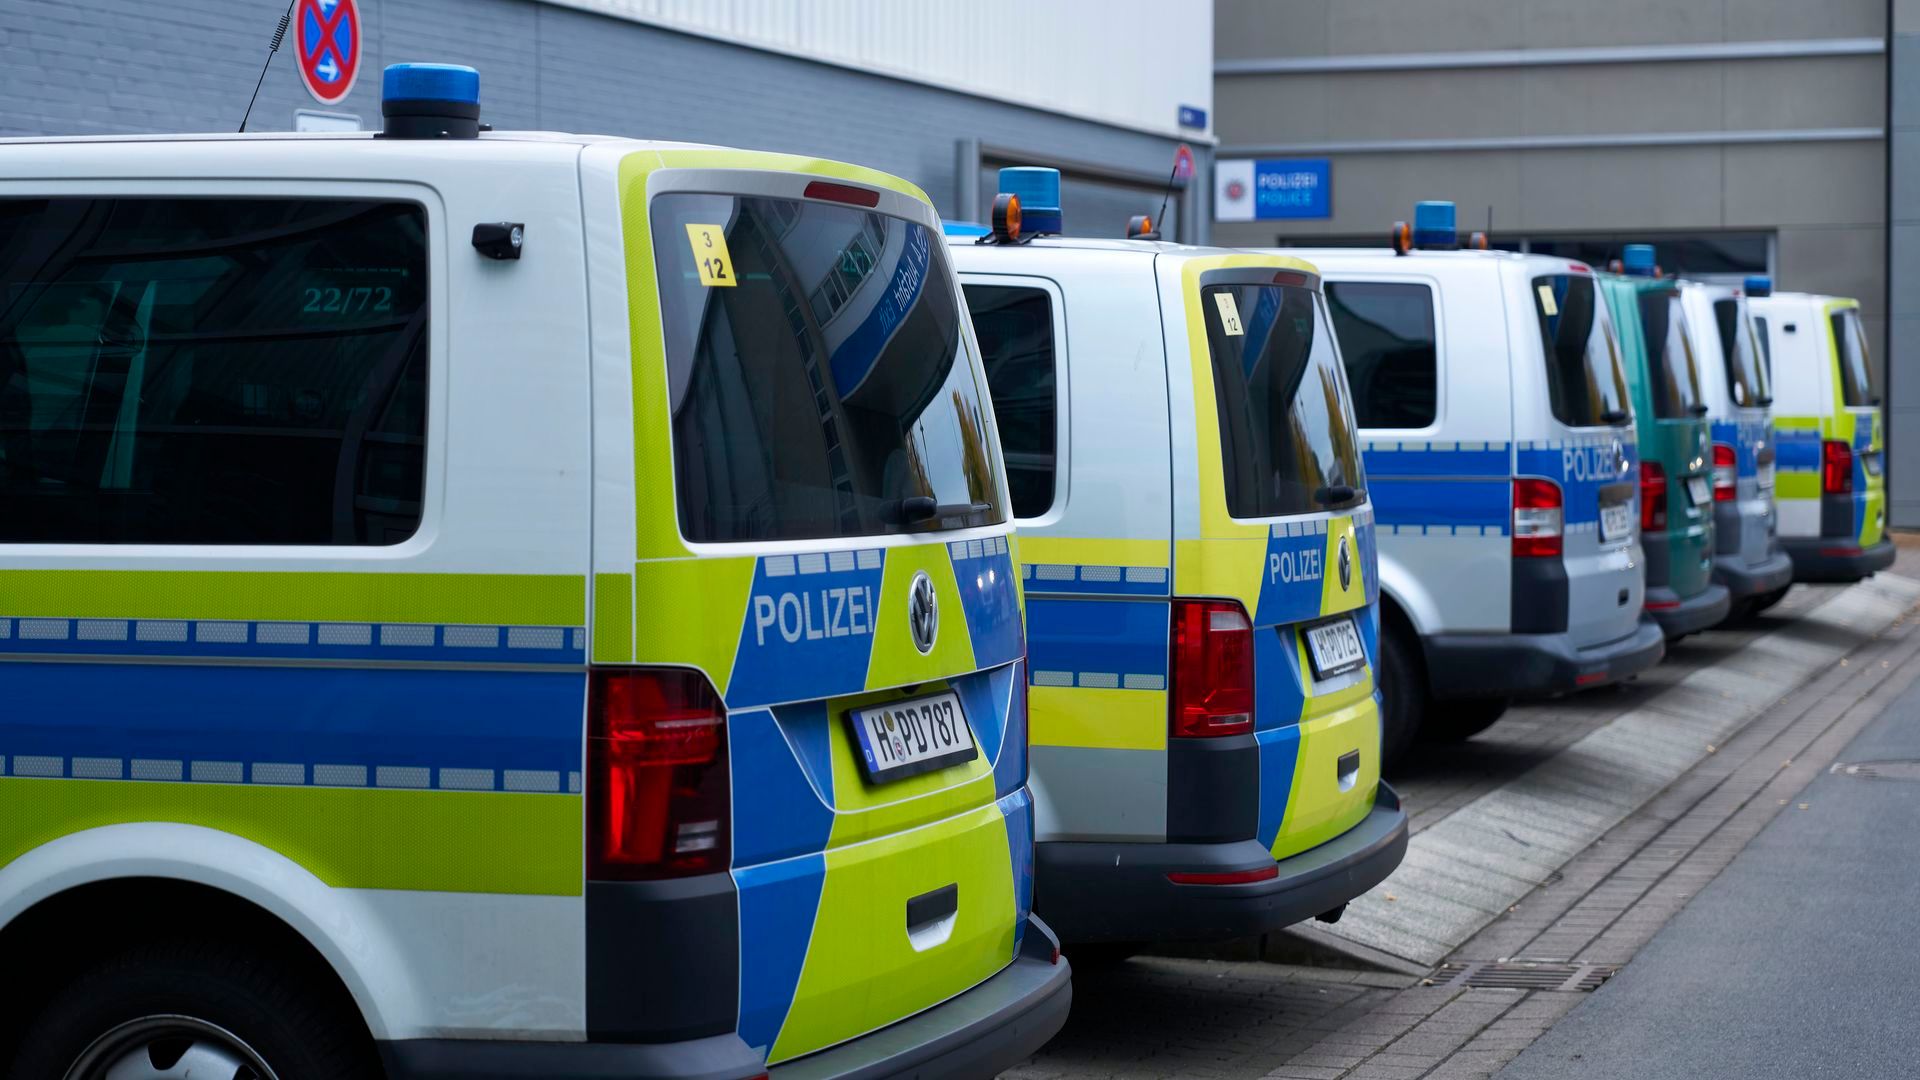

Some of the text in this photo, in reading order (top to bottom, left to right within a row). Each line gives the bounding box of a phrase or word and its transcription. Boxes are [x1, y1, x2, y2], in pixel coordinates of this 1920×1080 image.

[703, 231, 712, 248] 3
[704, 257, 727, 279] 12
[303, 286, 392, 315] 22/72
[1227, 317, 1238, 331] 12
[1270, 549, 1322, 584] POLIZEI
[754, 586, 874, 646] POLIZEI
[871, 713, 896, 762] H
[920, 700, 960, 750] 787
